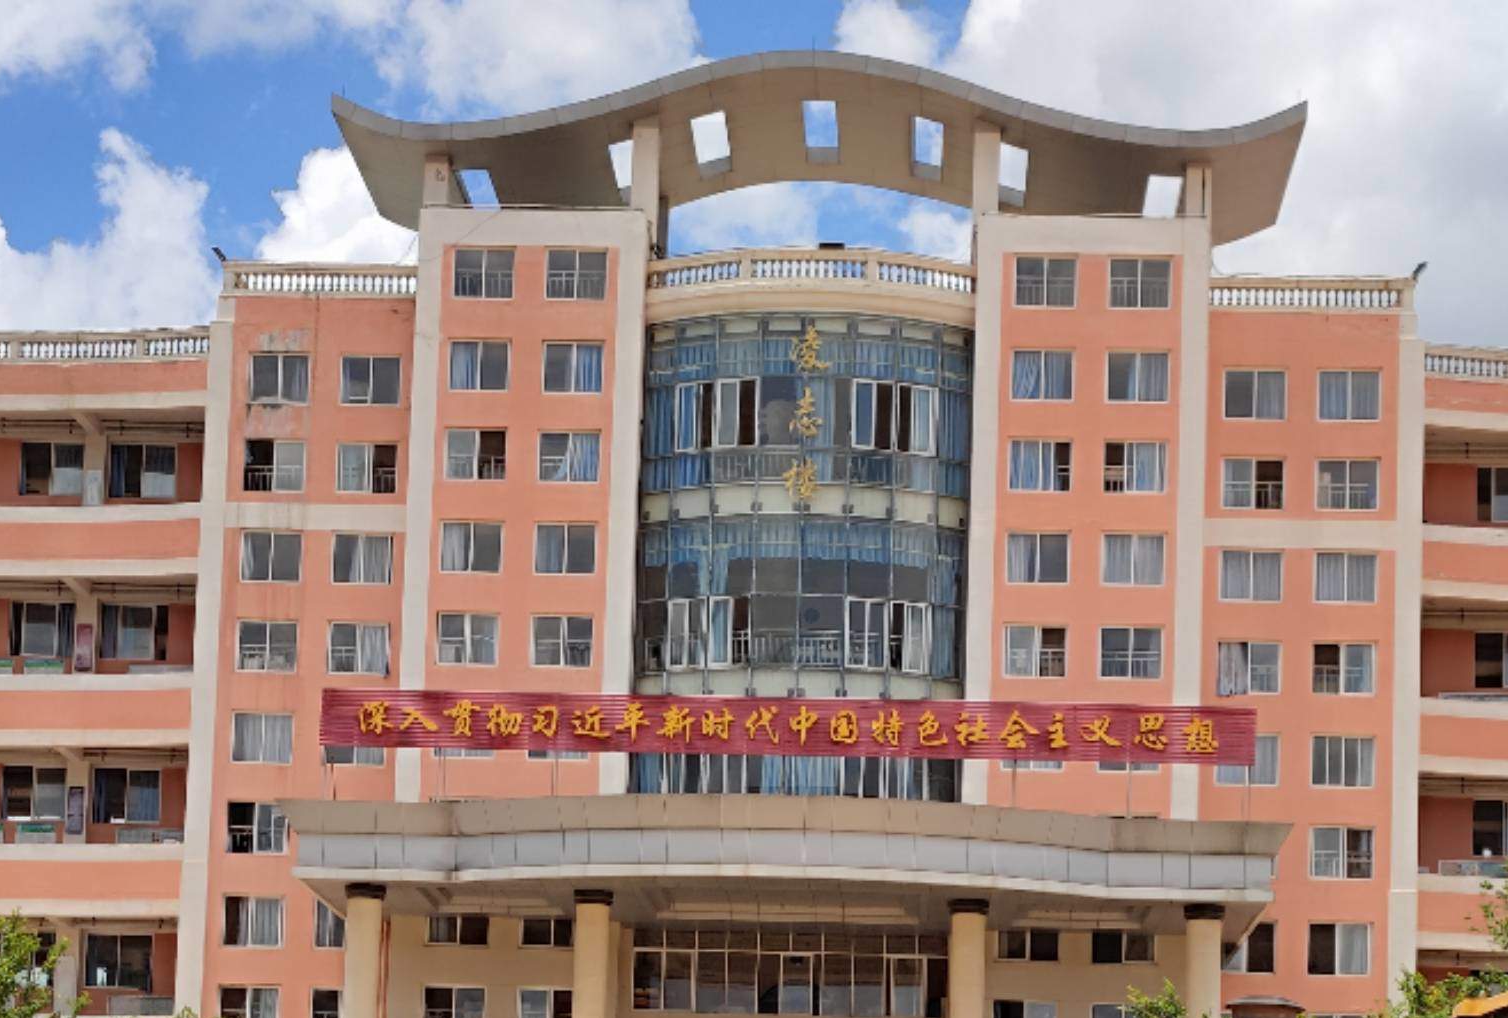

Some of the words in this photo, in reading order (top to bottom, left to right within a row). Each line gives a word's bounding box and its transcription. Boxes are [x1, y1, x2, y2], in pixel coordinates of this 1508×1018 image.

[357, 700, 1220, 754] 深入贯彻习近平新时代中国特色社会主义思想
